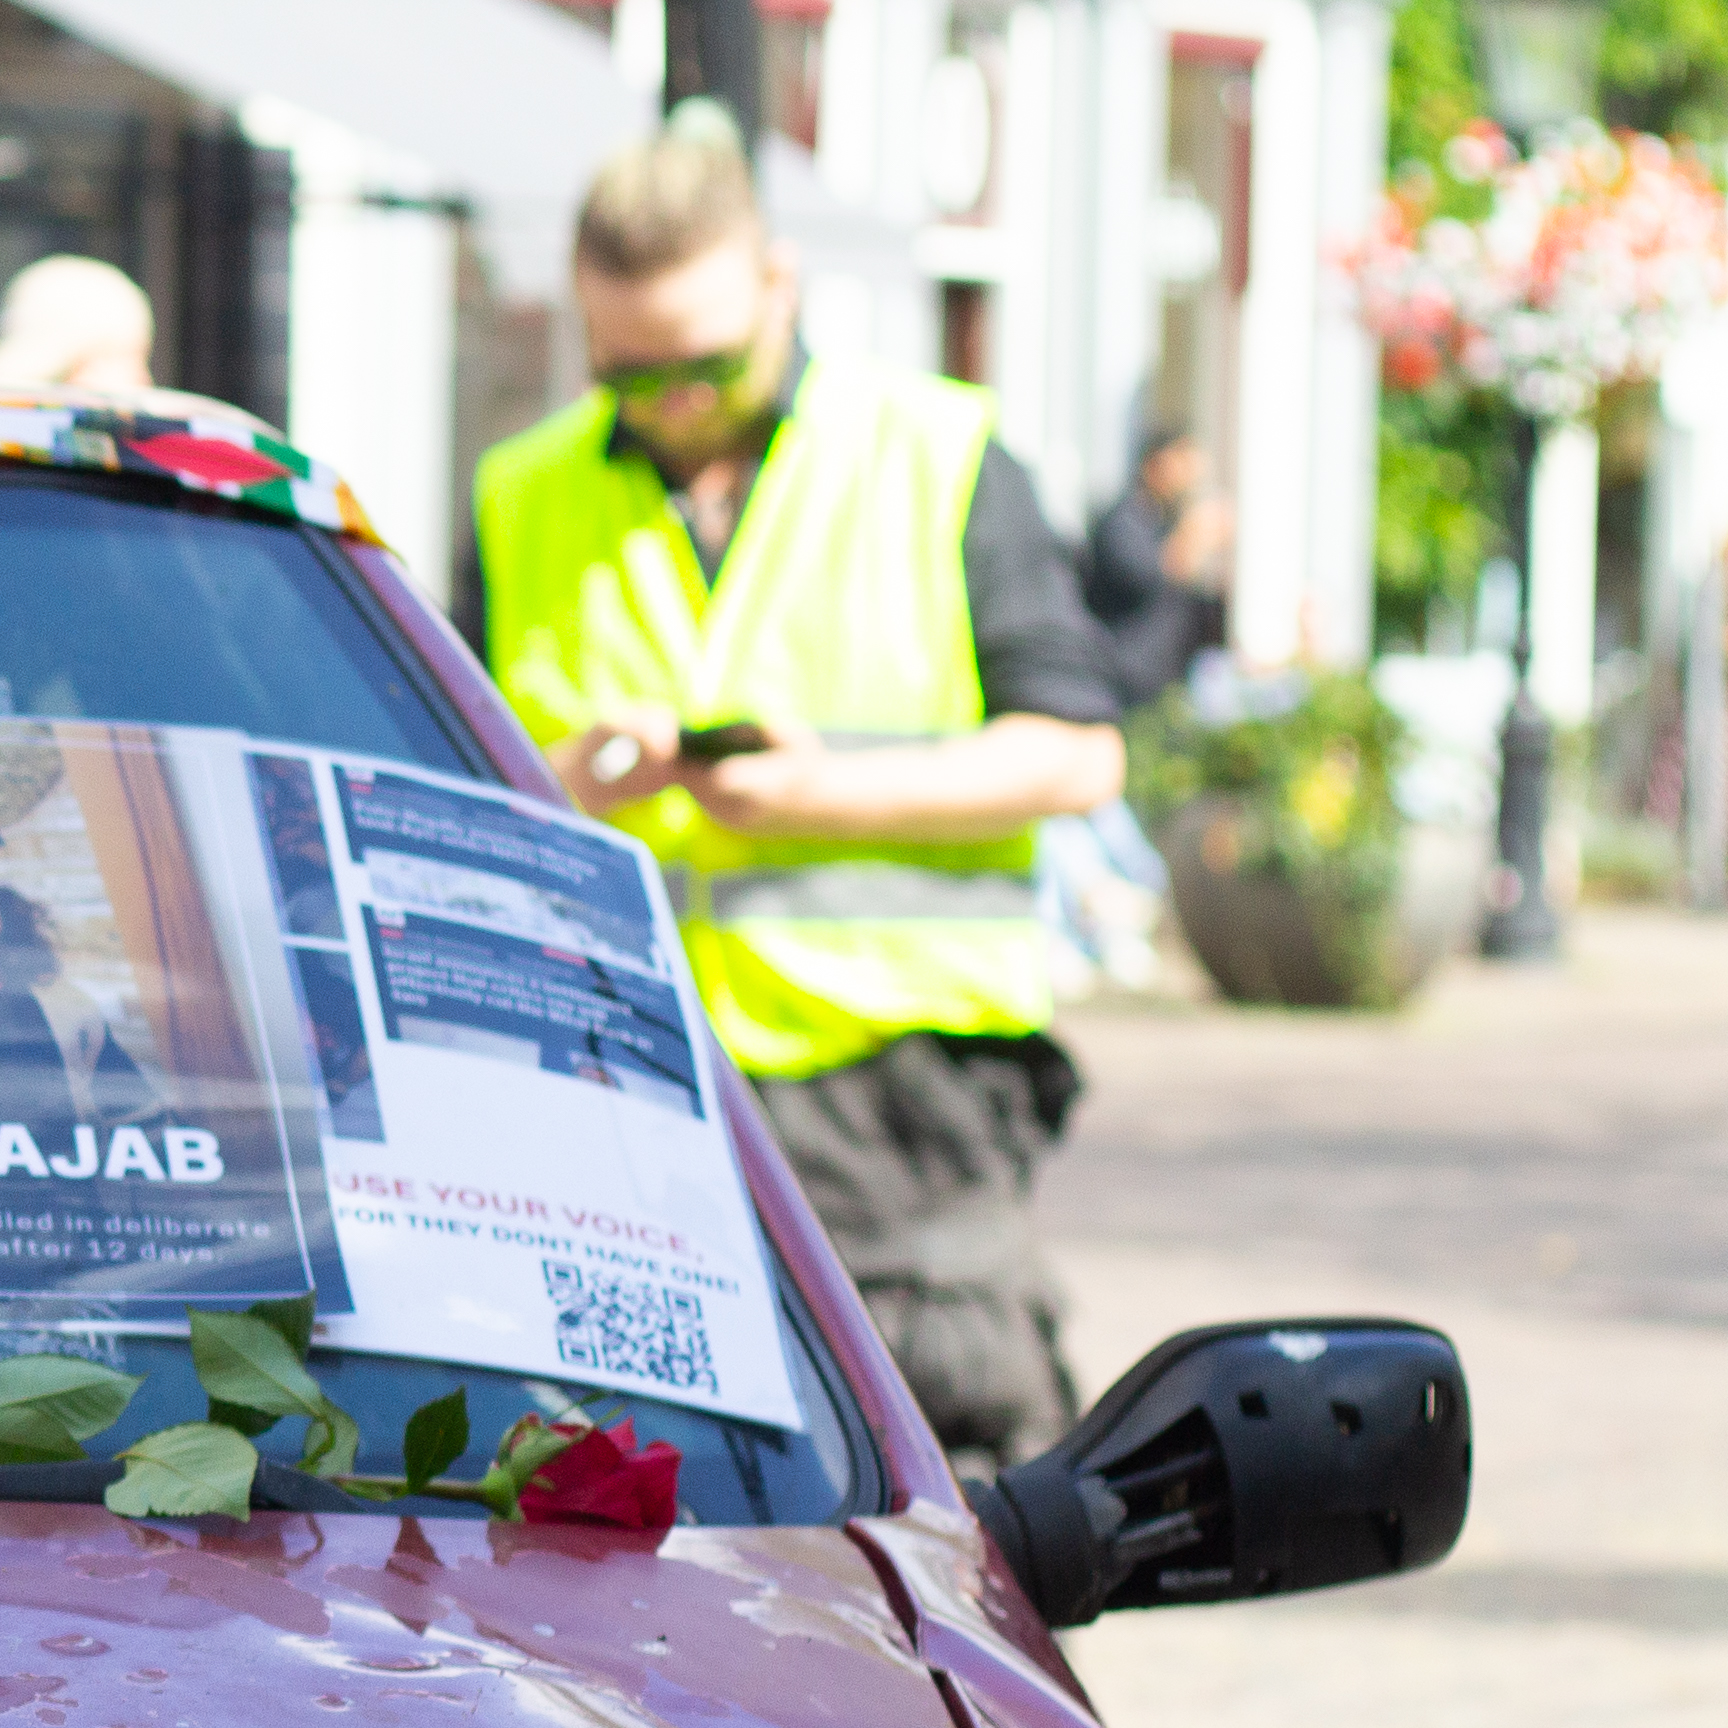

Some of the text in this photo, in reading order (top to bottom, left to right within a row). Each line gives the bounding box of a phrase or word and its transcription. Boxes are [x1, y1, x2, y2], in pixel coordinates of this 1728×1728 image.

[63, 1212, 93, 1233] in
[103, 1212, 272, 1240] deliberate
[333, 1172, 705, 1265] USE YOUR VOICE,
[87, 1239, 128, 1261] 12
[337, 1206, 741, 1297] FOR THEY DONT HAVE ONE!
